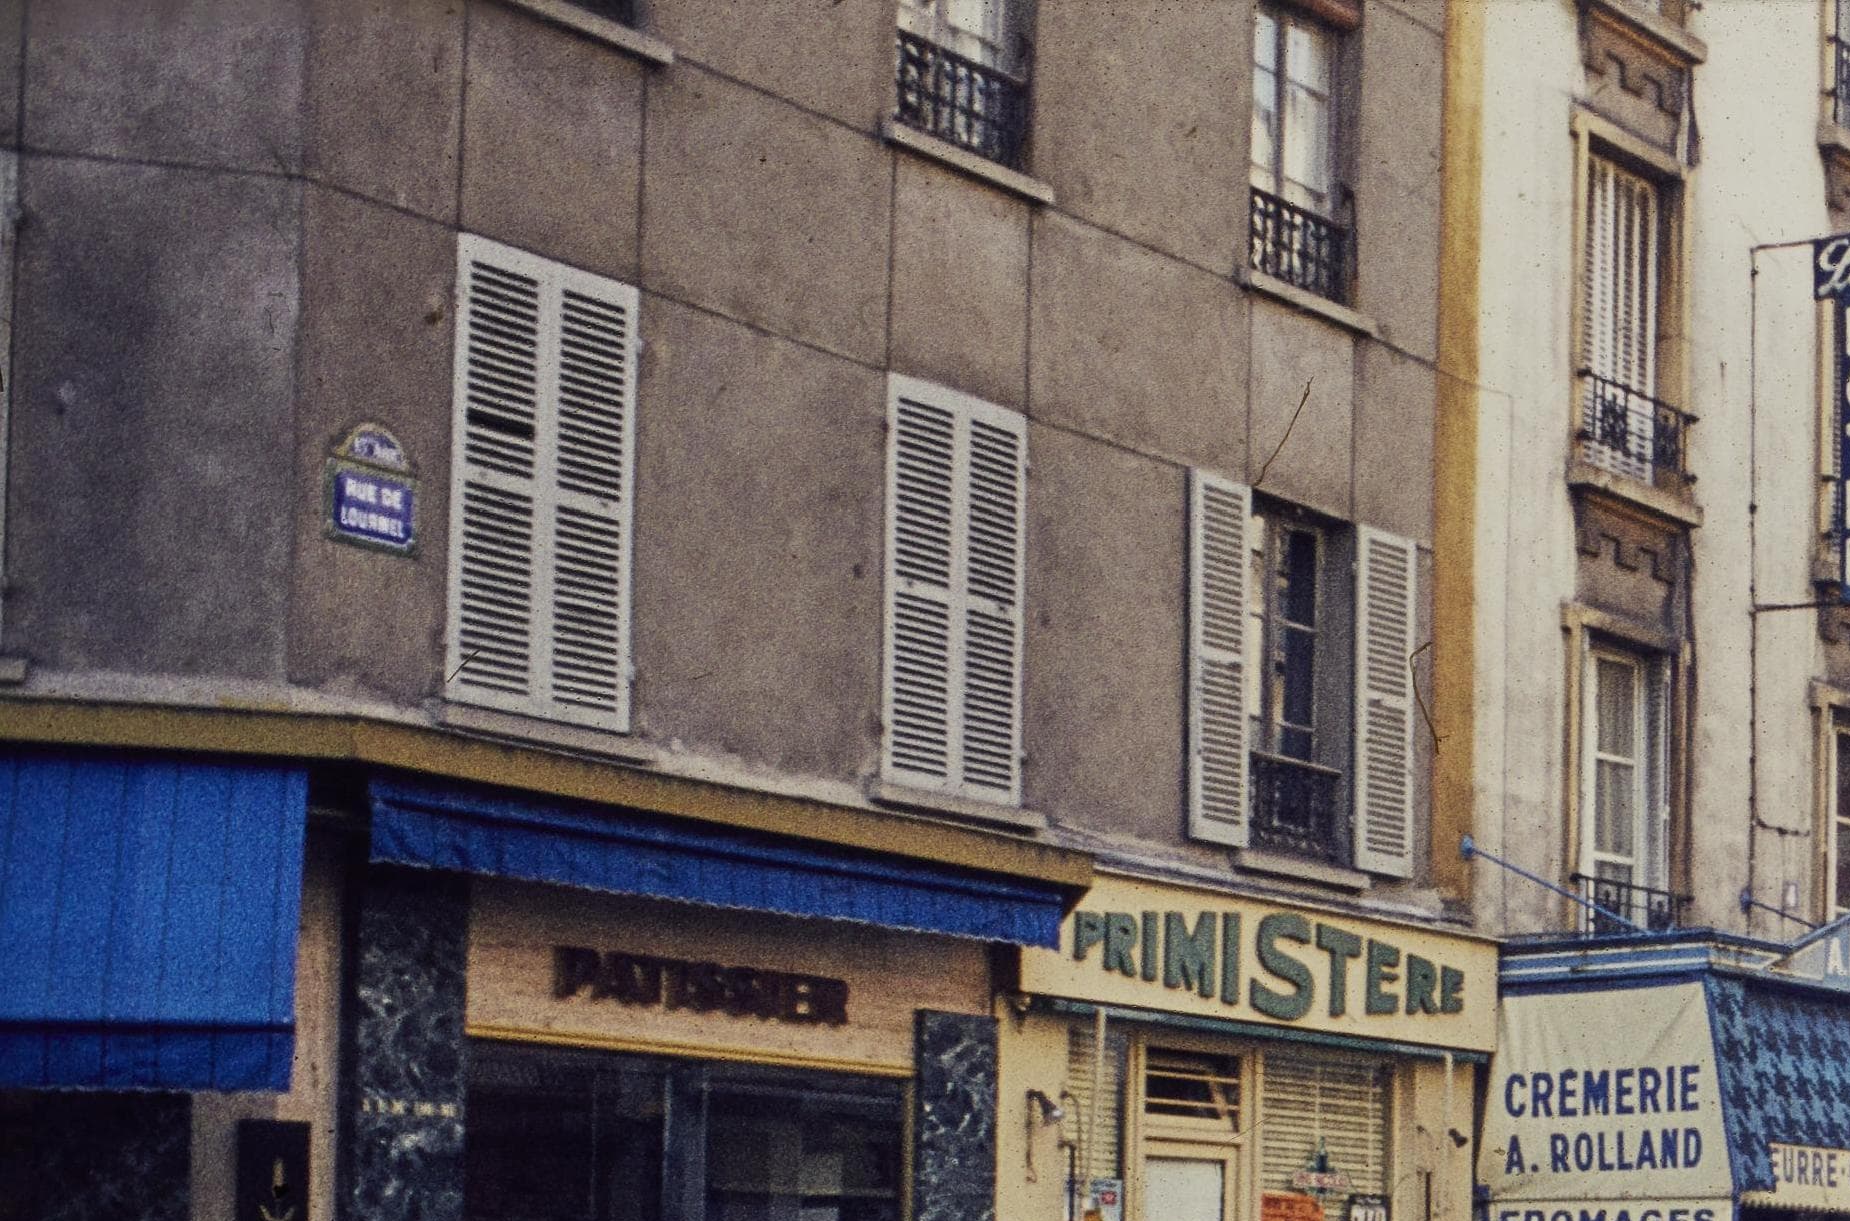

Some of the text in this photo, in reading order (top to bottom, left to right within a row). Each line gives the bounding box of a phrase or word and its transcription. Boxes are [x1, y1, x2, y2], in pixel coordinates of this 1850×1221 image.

[345, 478, 402, 510] RUE DE
[1073, 910, 1464, 1021] PRIMISTERE
[1505, 1127, 1702, 1174] A. ROLLAND
